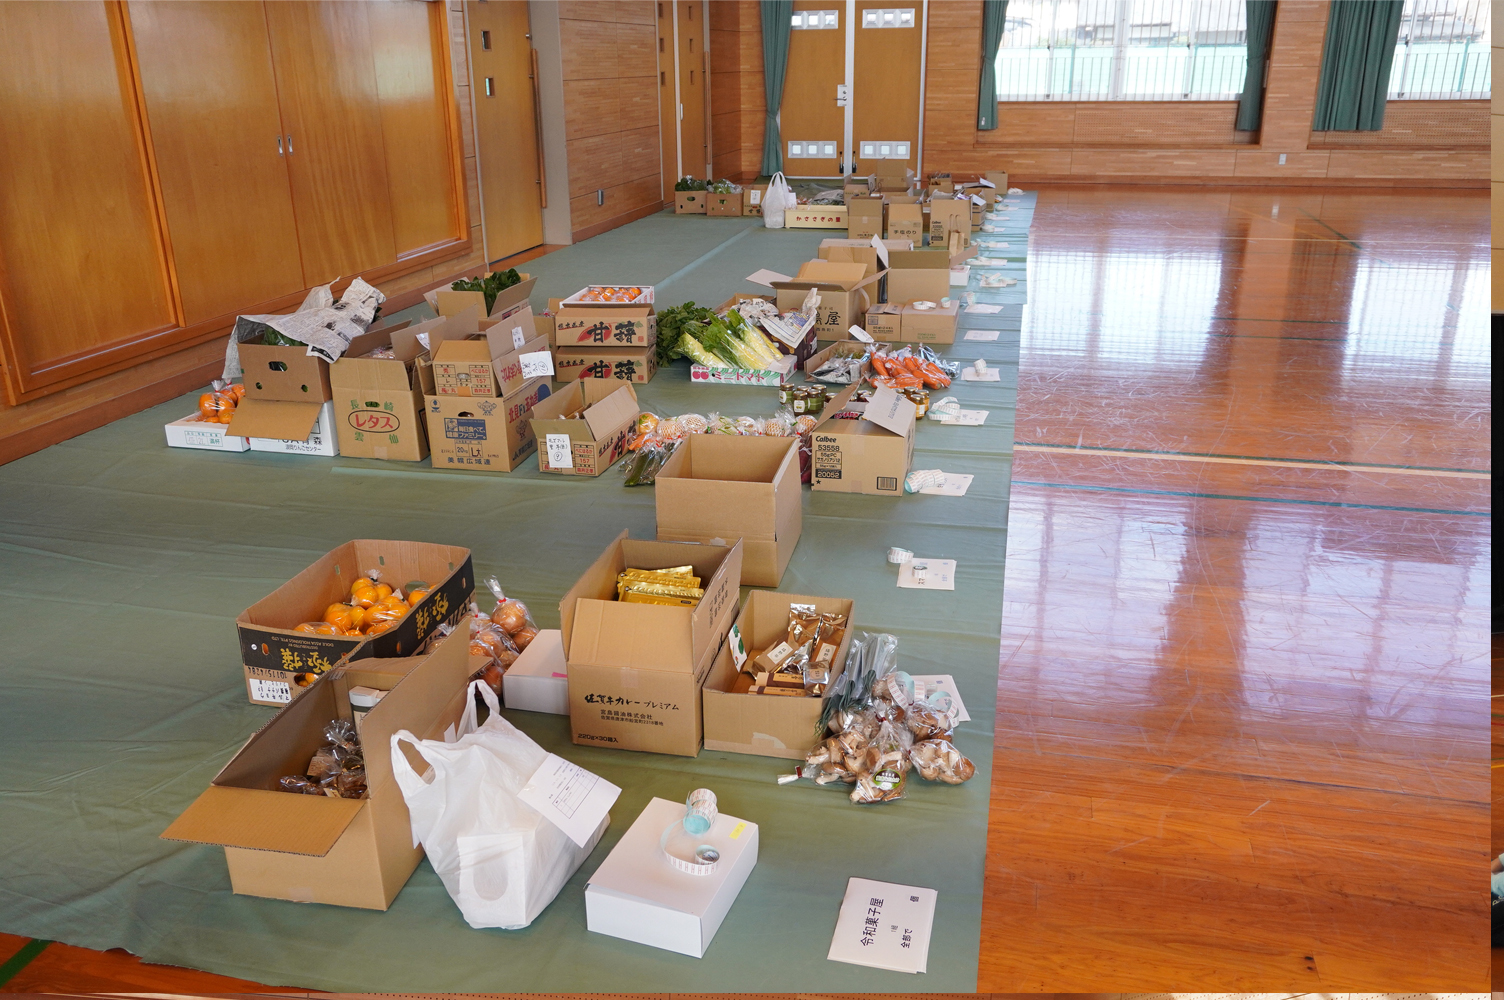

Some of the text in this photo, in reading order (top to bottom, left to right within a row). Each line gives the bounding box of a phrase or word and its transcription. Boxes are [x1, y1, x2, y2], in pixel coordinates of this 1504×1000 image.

[714, 371, 765, 382] ミニトマト
[350, 399, 394, 412] 長崎
[354, 414, 394, 429] レタス
[354, 431, 399, 445] 雲仙
[584, 693, 680, 710] 佐賀牛カレー プレミアム
[860, 897, 884, 946] 令和菓子屋
[900, 928, 913, 949] 全部で
